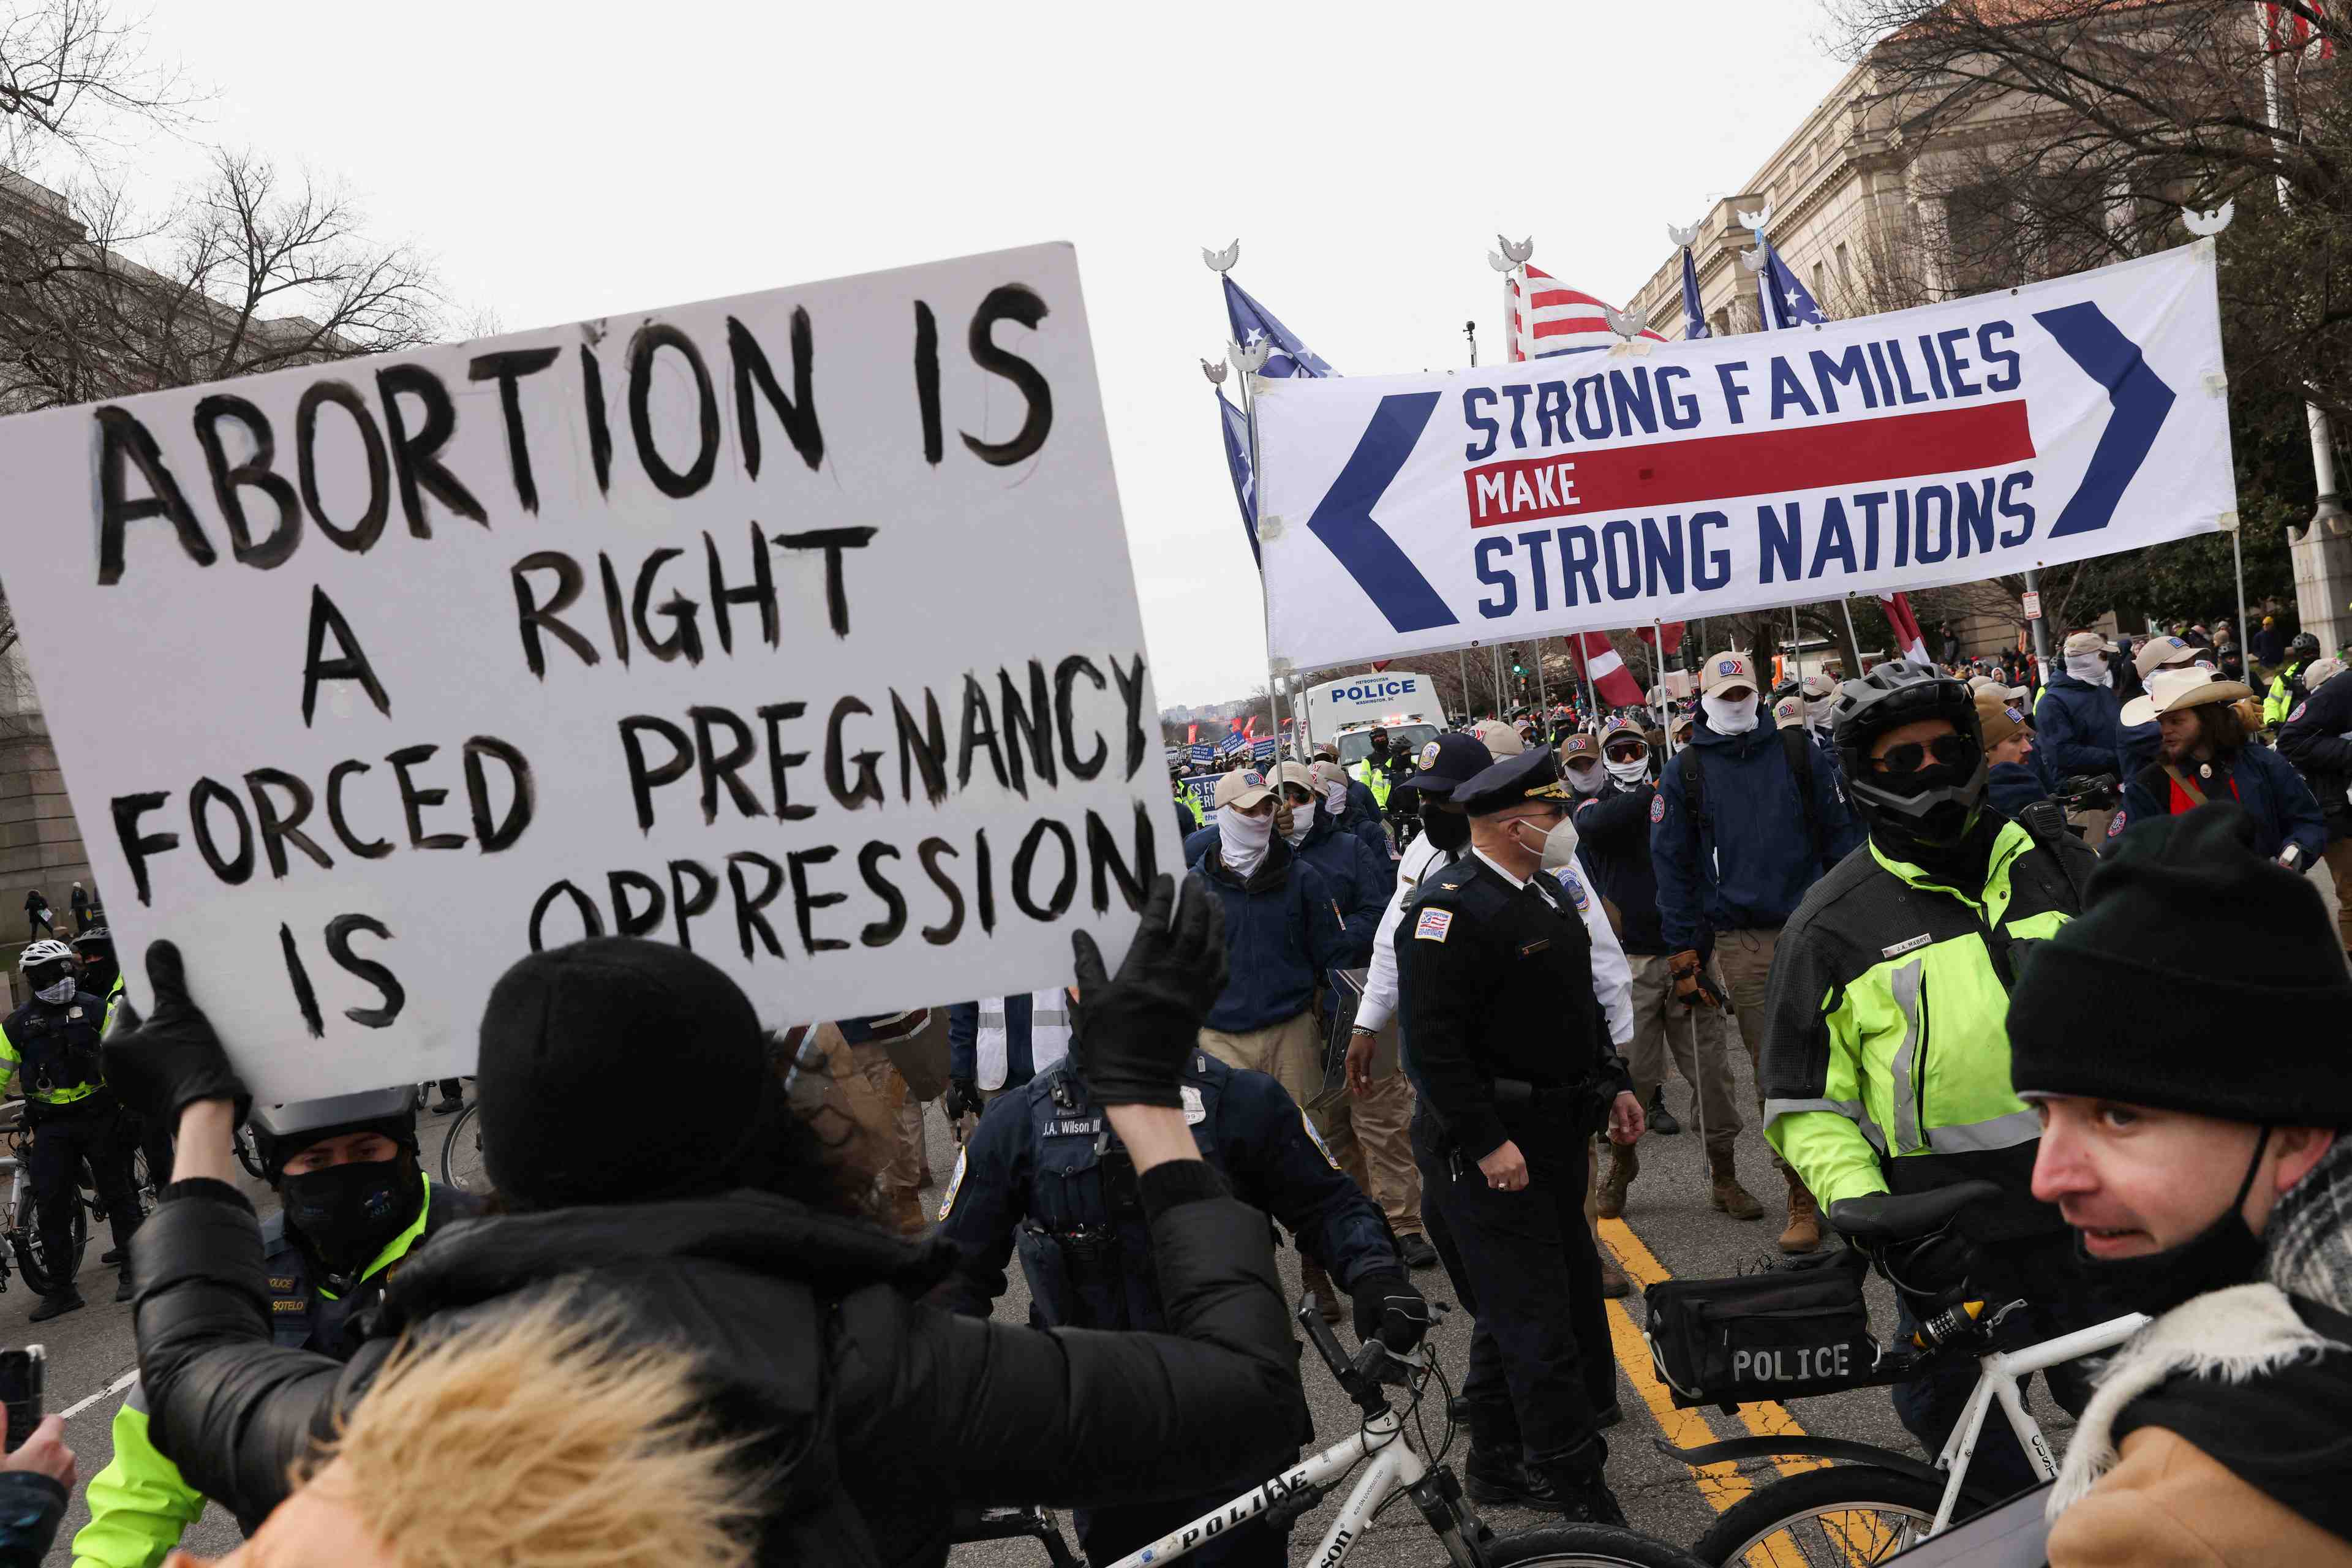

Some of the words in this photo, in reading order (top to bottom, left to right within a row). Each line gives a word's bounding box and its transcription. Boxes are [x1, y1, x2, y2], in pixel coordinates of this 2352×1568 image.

[1464, 365, 1702, 462] STRONG
[1715, 320, 2020, 424] FAMILIES
[93, 304, 824, 586] ABORTION
[914, 282, 1054, 467] IS
[1475, 462, 1581, 518] MAKE
[1474, 512, 1731, 619] STRONG
[1758, 471, 2035, 584] NATIONS
[301, 583, 391, 729] A
[510, 520, 878, 681] RIGHT
[1332, 679, 1416, 703] POLICE
[1355, 677, 1389, 685] METROPOLITAN
[110, 735, 535, 908] FORCED
[617, 652, 1147, 837] PREGNANCY
[279, 913, 405, 1039] IS
[529, 799, 1157, 963] OPPRESSION
[1043, 1122, 1058, 1136] J.A.
[1061, 1120, 1090, 1134] Wilson
[1092, 1118, 1101, 1132] III
[273, 1300, 304, 1311] SOTELO
[1733, 1343, 1850, 1382] POLICE
[1384, 1417, 1392, 1426] 2
